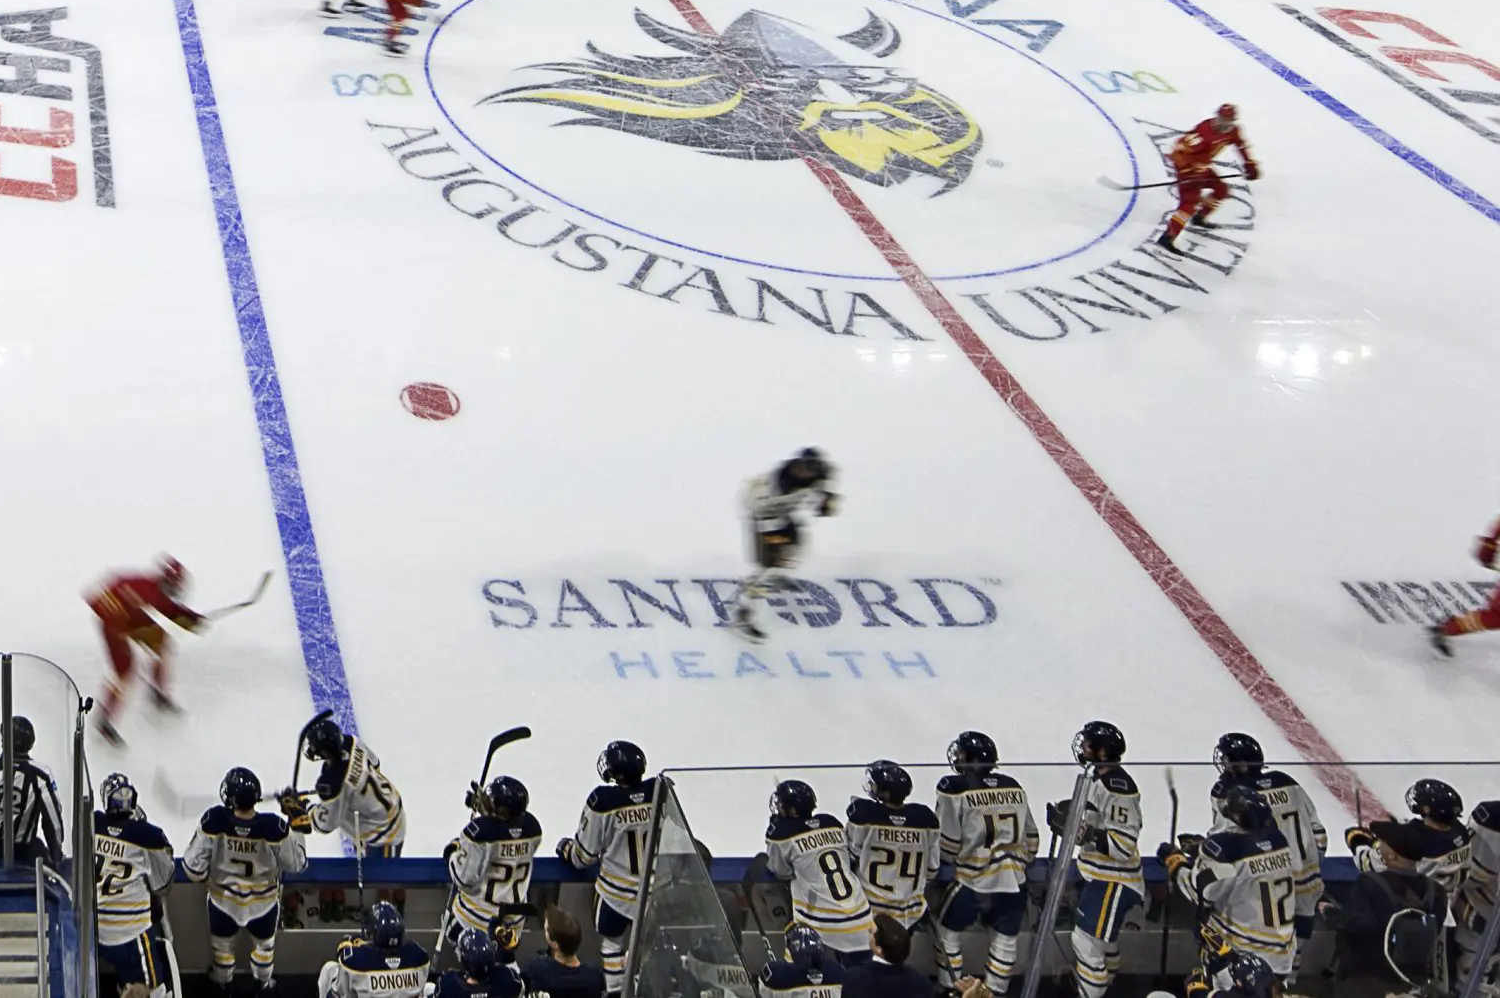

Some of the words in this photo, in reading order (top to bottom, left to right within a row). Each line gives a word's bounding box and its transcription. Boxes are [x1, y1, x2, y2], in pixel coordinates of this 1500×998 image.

[364, 119, 936, 342] AUGUSTANA
[480, 577, 1000, 631] SANFORD
[606, 650, 939, 680] HEALTH
[965, 789, 1025, 808] NAUMOVSKI
[1109, 804, 1129, 825] 15
[794, 830, 844, 854] TROUMBLY
[877, 827, 921, 845] FRIESEN
[982, 812, 1019, 850] 17
[96, 838, 126, 859] KOTAI
[227, 839, 259, 854] STARK
[500, 842, 530, 859] ZIEMER
[817, 849, 852, 902] 8
[867, 845, 924, 893] 24
[1249, 851, 1292, 877] BISCHOFF
[1258, 876, 1294, 928] 12
[369, 972, 420, 991] DONOVAN
